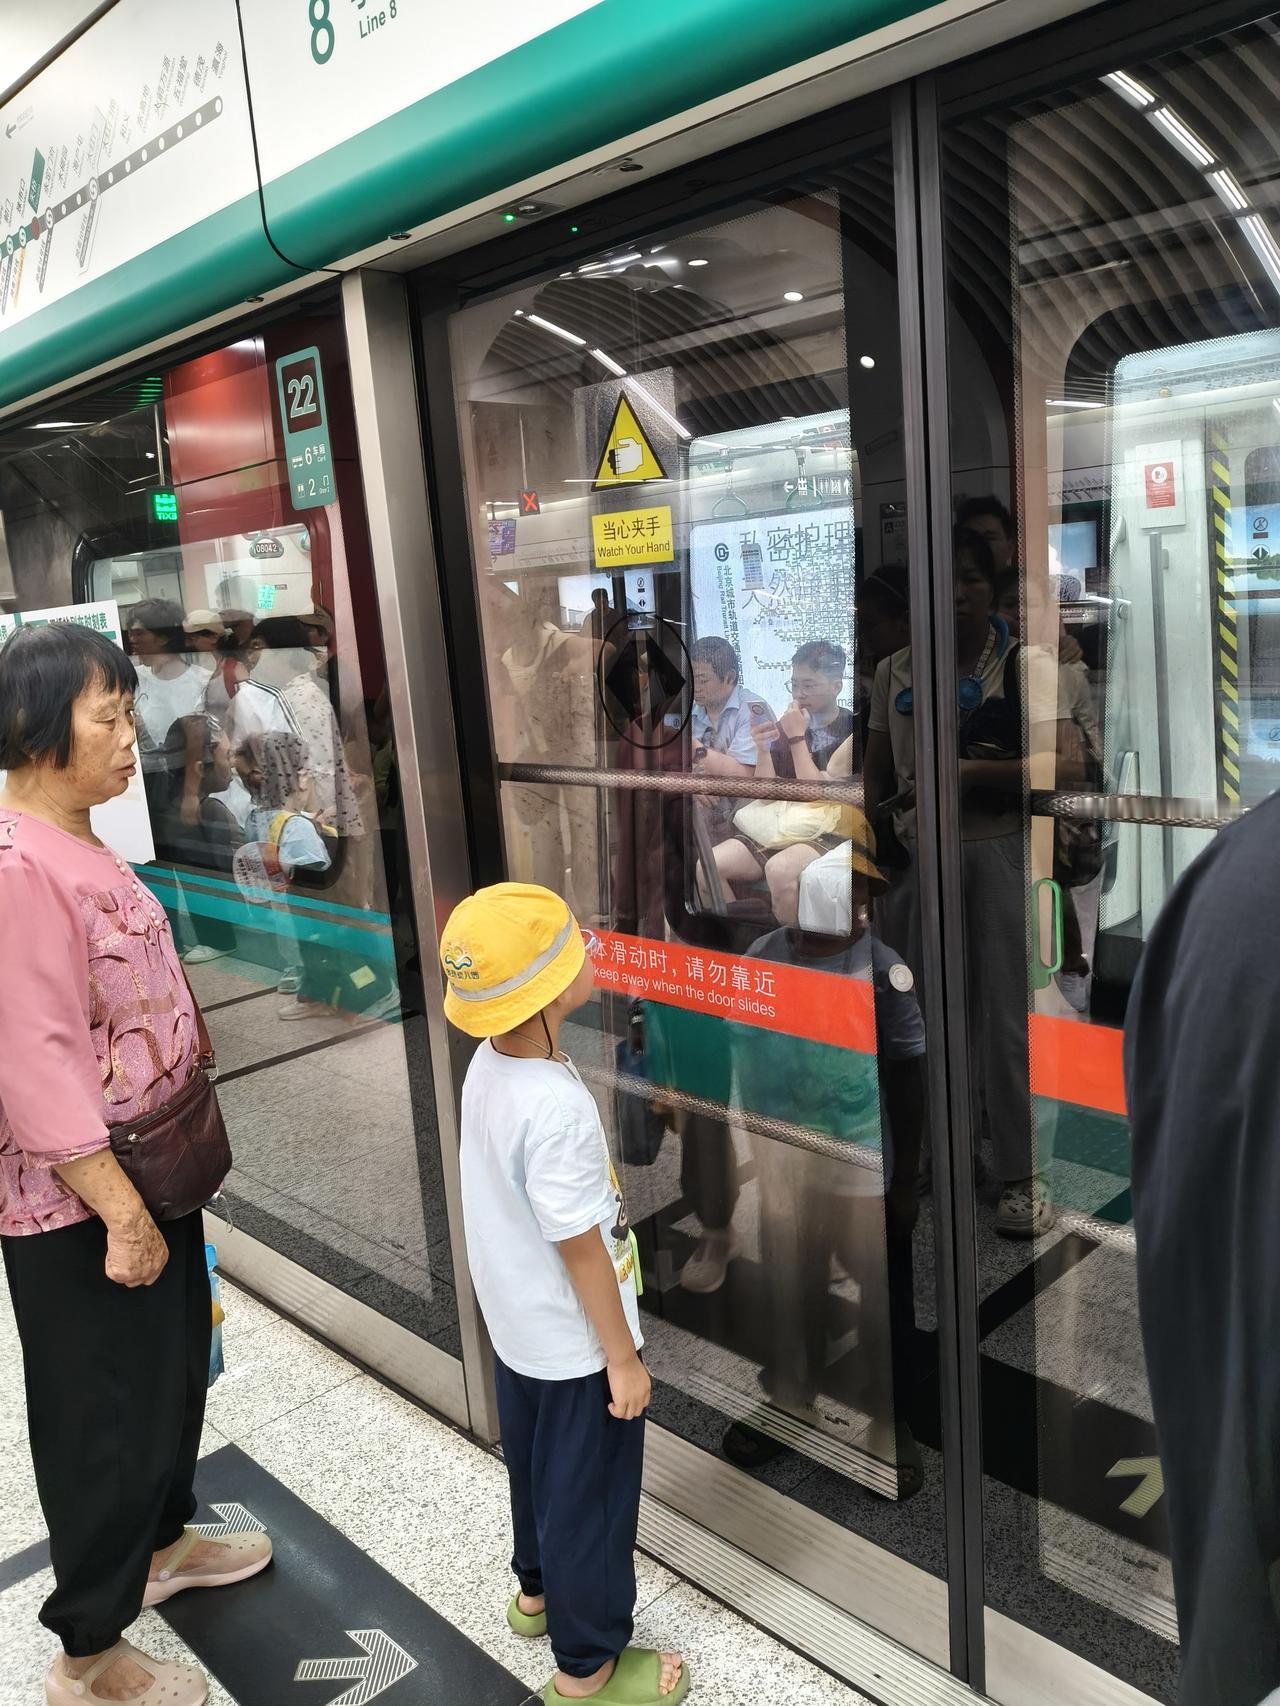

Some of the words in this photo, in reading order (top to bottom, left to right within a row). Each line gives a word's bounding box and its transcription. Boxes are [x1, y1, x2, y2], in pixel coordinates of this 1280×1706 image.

[309, 0, 335, 64] 8
[359, 11, 386, 38] Line
[390, 0, 397, 18] 8
[287, 374, 317, 419] 22
[305, 447, 312, 465] 6
[309, 478, 316, 496] 2
[603, 515, 661, 541] 当心夹手
[256, 543, 277, 554] 08042
[598, 545, 624, 558] Watch
[625, 543, 645, 555] Your
[647, 541, 671, 553] Hand
[594, 966, 619, 983] keep
[621, 971, 650, 991] away
[652, 978, 683, 997] when
[685, 984, 704, 1001] the
[707, 990, 734, 1007] door
[738, 997, 776, 1018] slides
